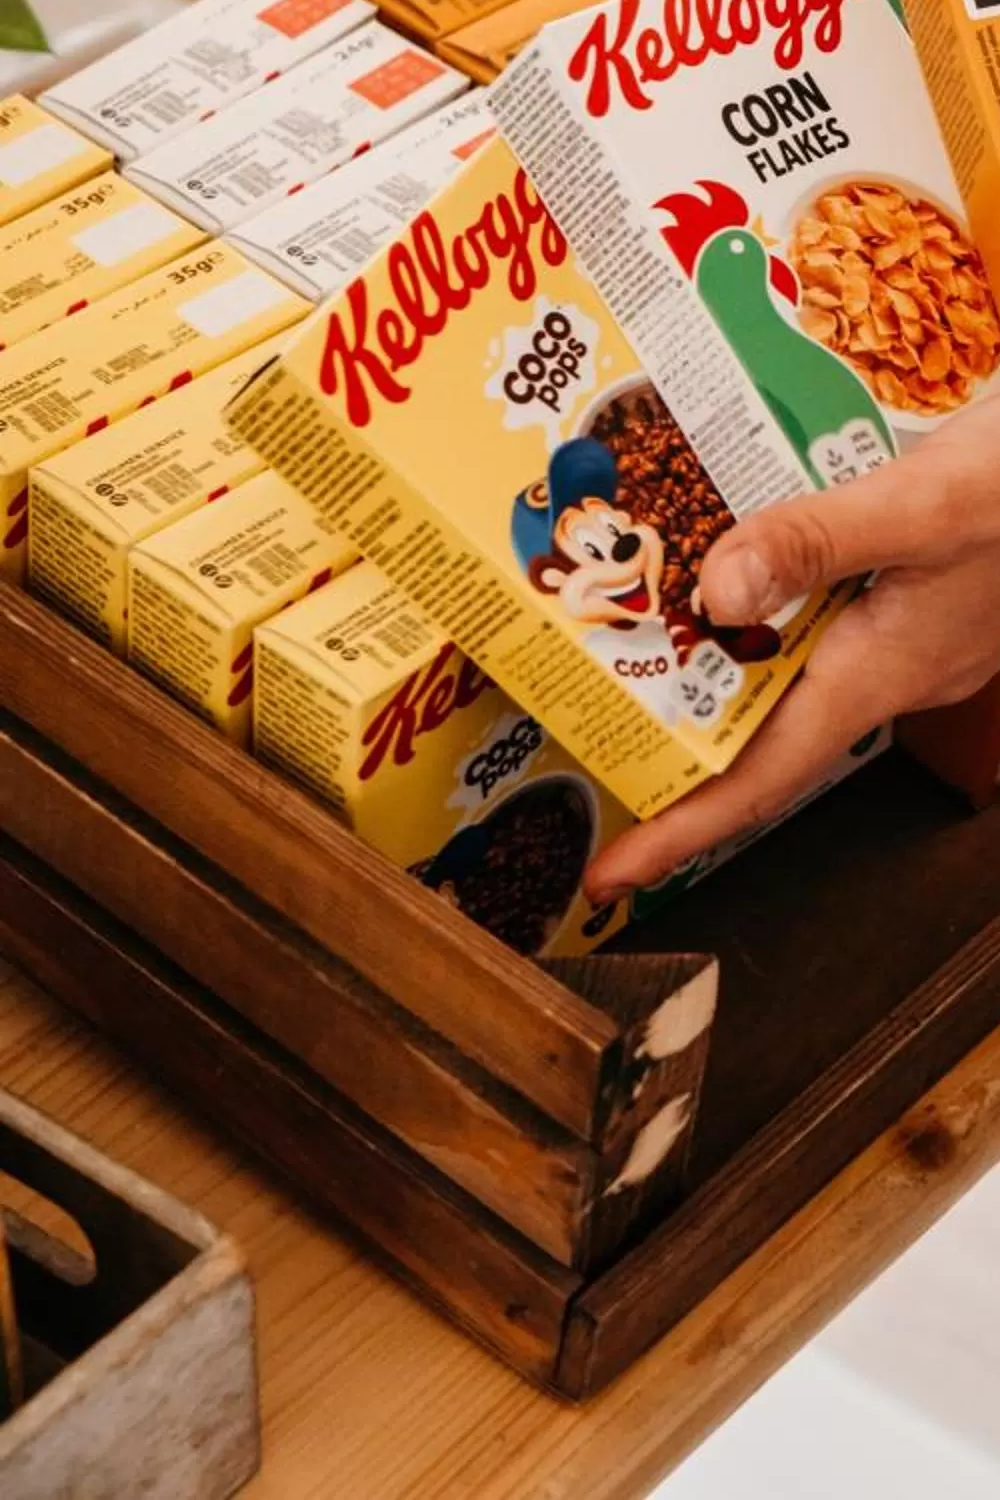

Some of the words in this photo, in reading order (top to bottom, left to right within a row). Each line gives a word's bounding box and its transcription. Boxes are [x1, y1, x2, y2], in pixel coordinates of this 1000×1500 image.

[721, 70, 832, 147] CORN
[746, 116, 851, 184] FLAKES
[318, 166, 568, 428] Kellogg
[536, 337, 588, 414] pops
